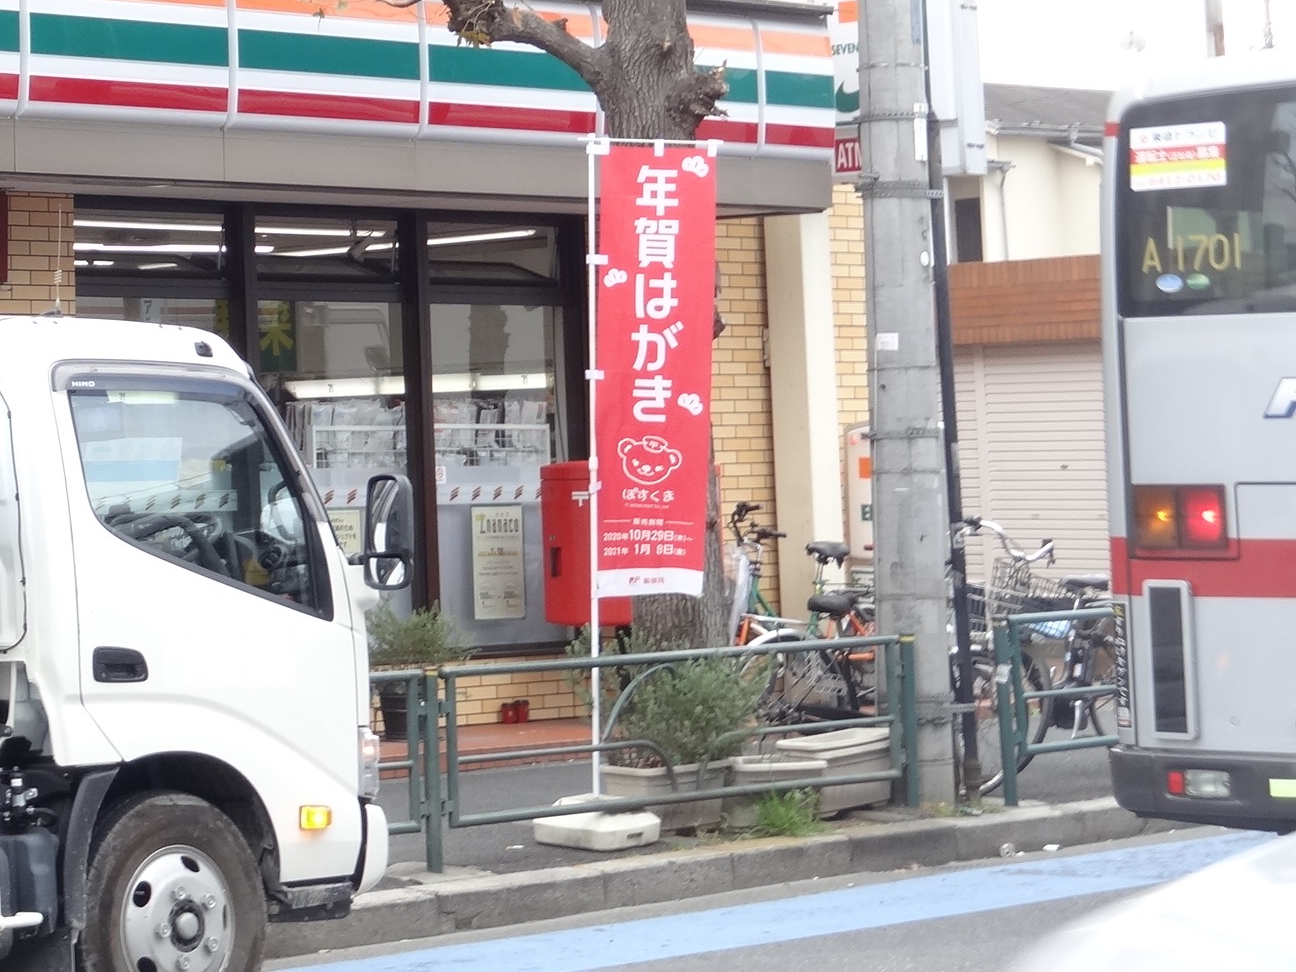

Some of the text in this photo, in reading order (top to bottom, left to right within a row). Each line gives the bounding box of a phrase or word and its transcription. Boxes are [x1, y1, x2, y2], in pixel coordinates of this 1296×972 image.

[631, 165, 684, 424] 年賀はがき
[71, 380, 96, 388] HINO
